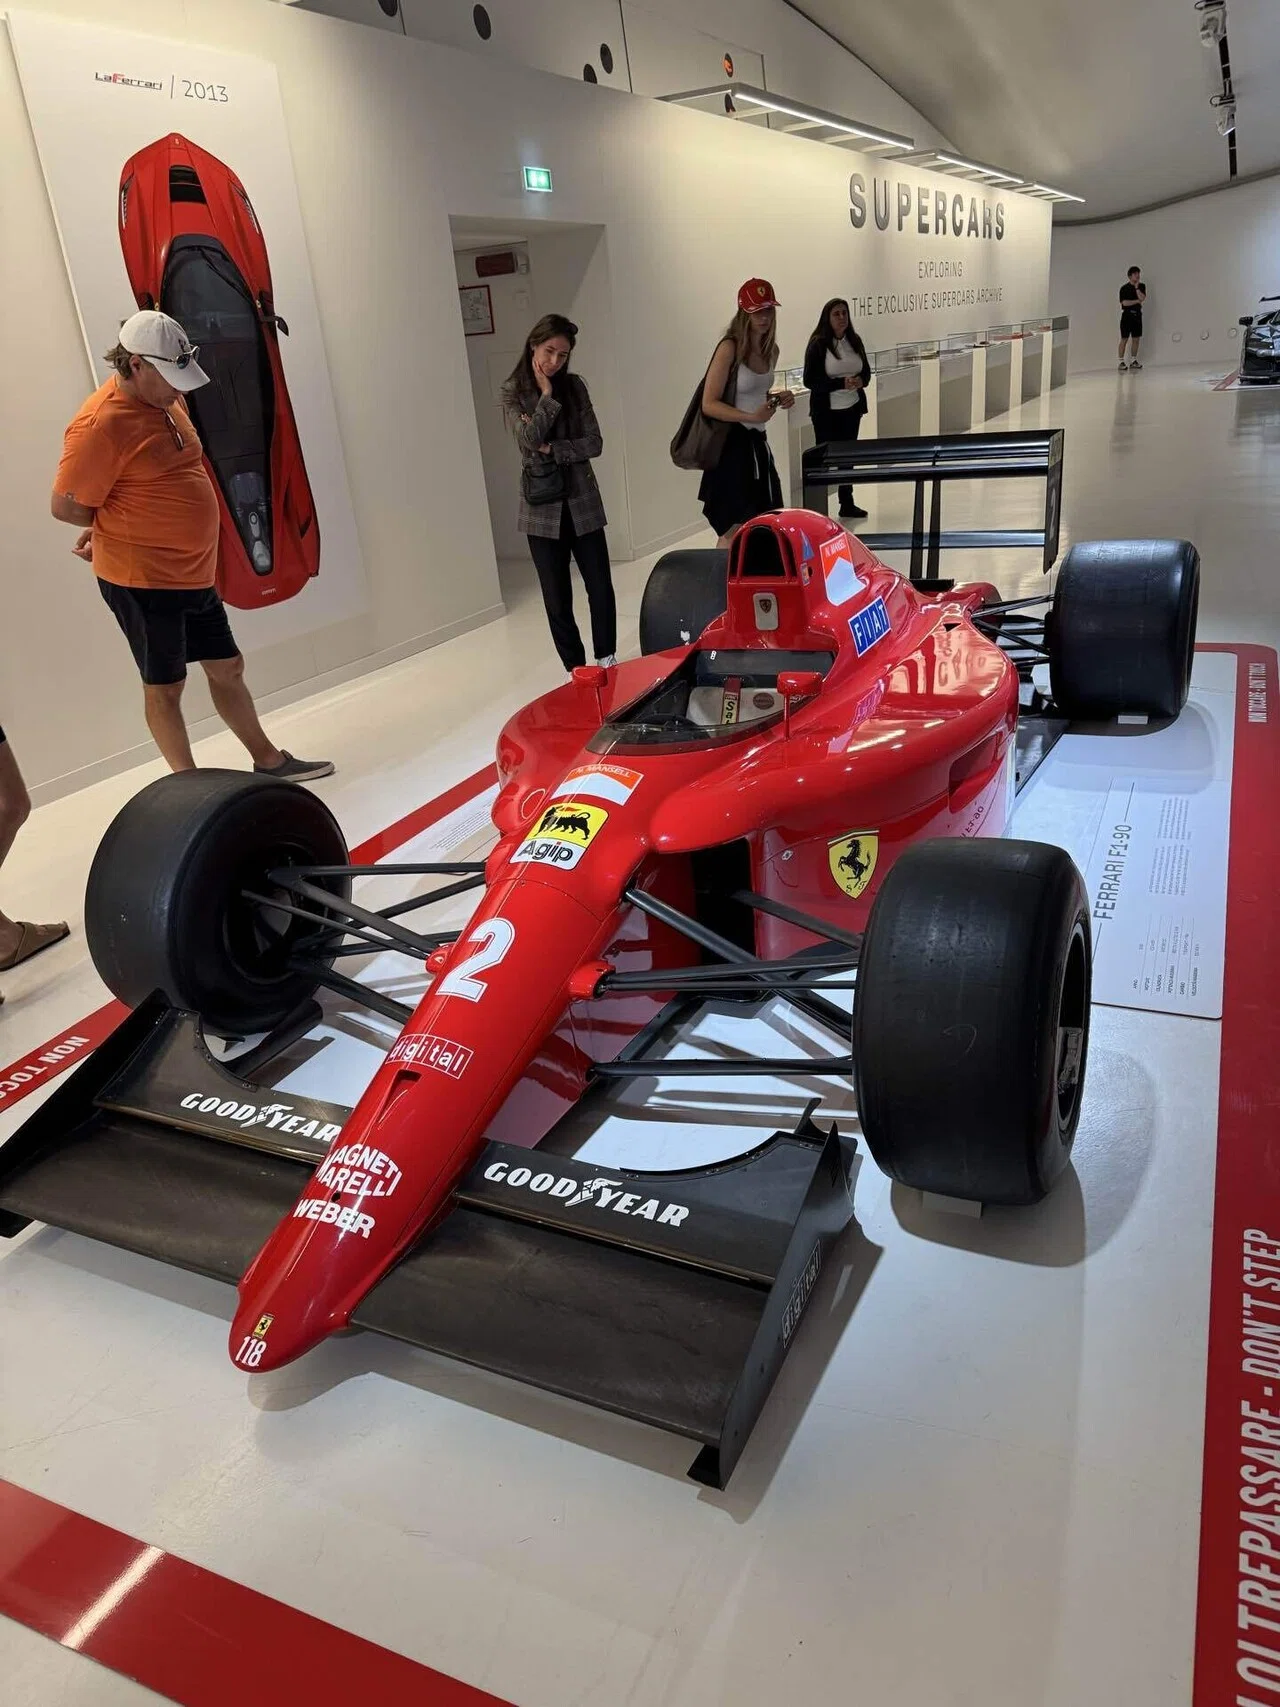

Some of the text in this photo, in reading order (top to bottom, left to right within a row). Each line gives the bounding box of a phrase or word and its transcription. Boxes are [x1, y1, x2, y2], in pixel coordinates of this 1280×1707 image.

[94, 72, 229, 103] LaFerrari 2013
[849, 172, 1005, 241] SUPERCARS
[918, 261, 963, 279] EXPLORING
[852, 287, 1003, 317] THE EXCLUSIVE SUPERCARS ARCHIVE
[853, 602, 888, 648] FIAT
[517, 840, 574, 863] Agip
[1093, 824, 1133, 921] FERRARI F1-90
[435, 917, 516, 1003] 2
[37, 1035, 91, 1064] NON
[388, 1038, 467, 1074] digital
[317, 1143, 402, 1188] MAGNETI
[292, 1198, 376, 1239] WEBER
[1242, 1227, 1280, 1292] STEP
[235, 1335, 267, 1367] 118
[1241, 1292, 1280, 1380] DON'T
